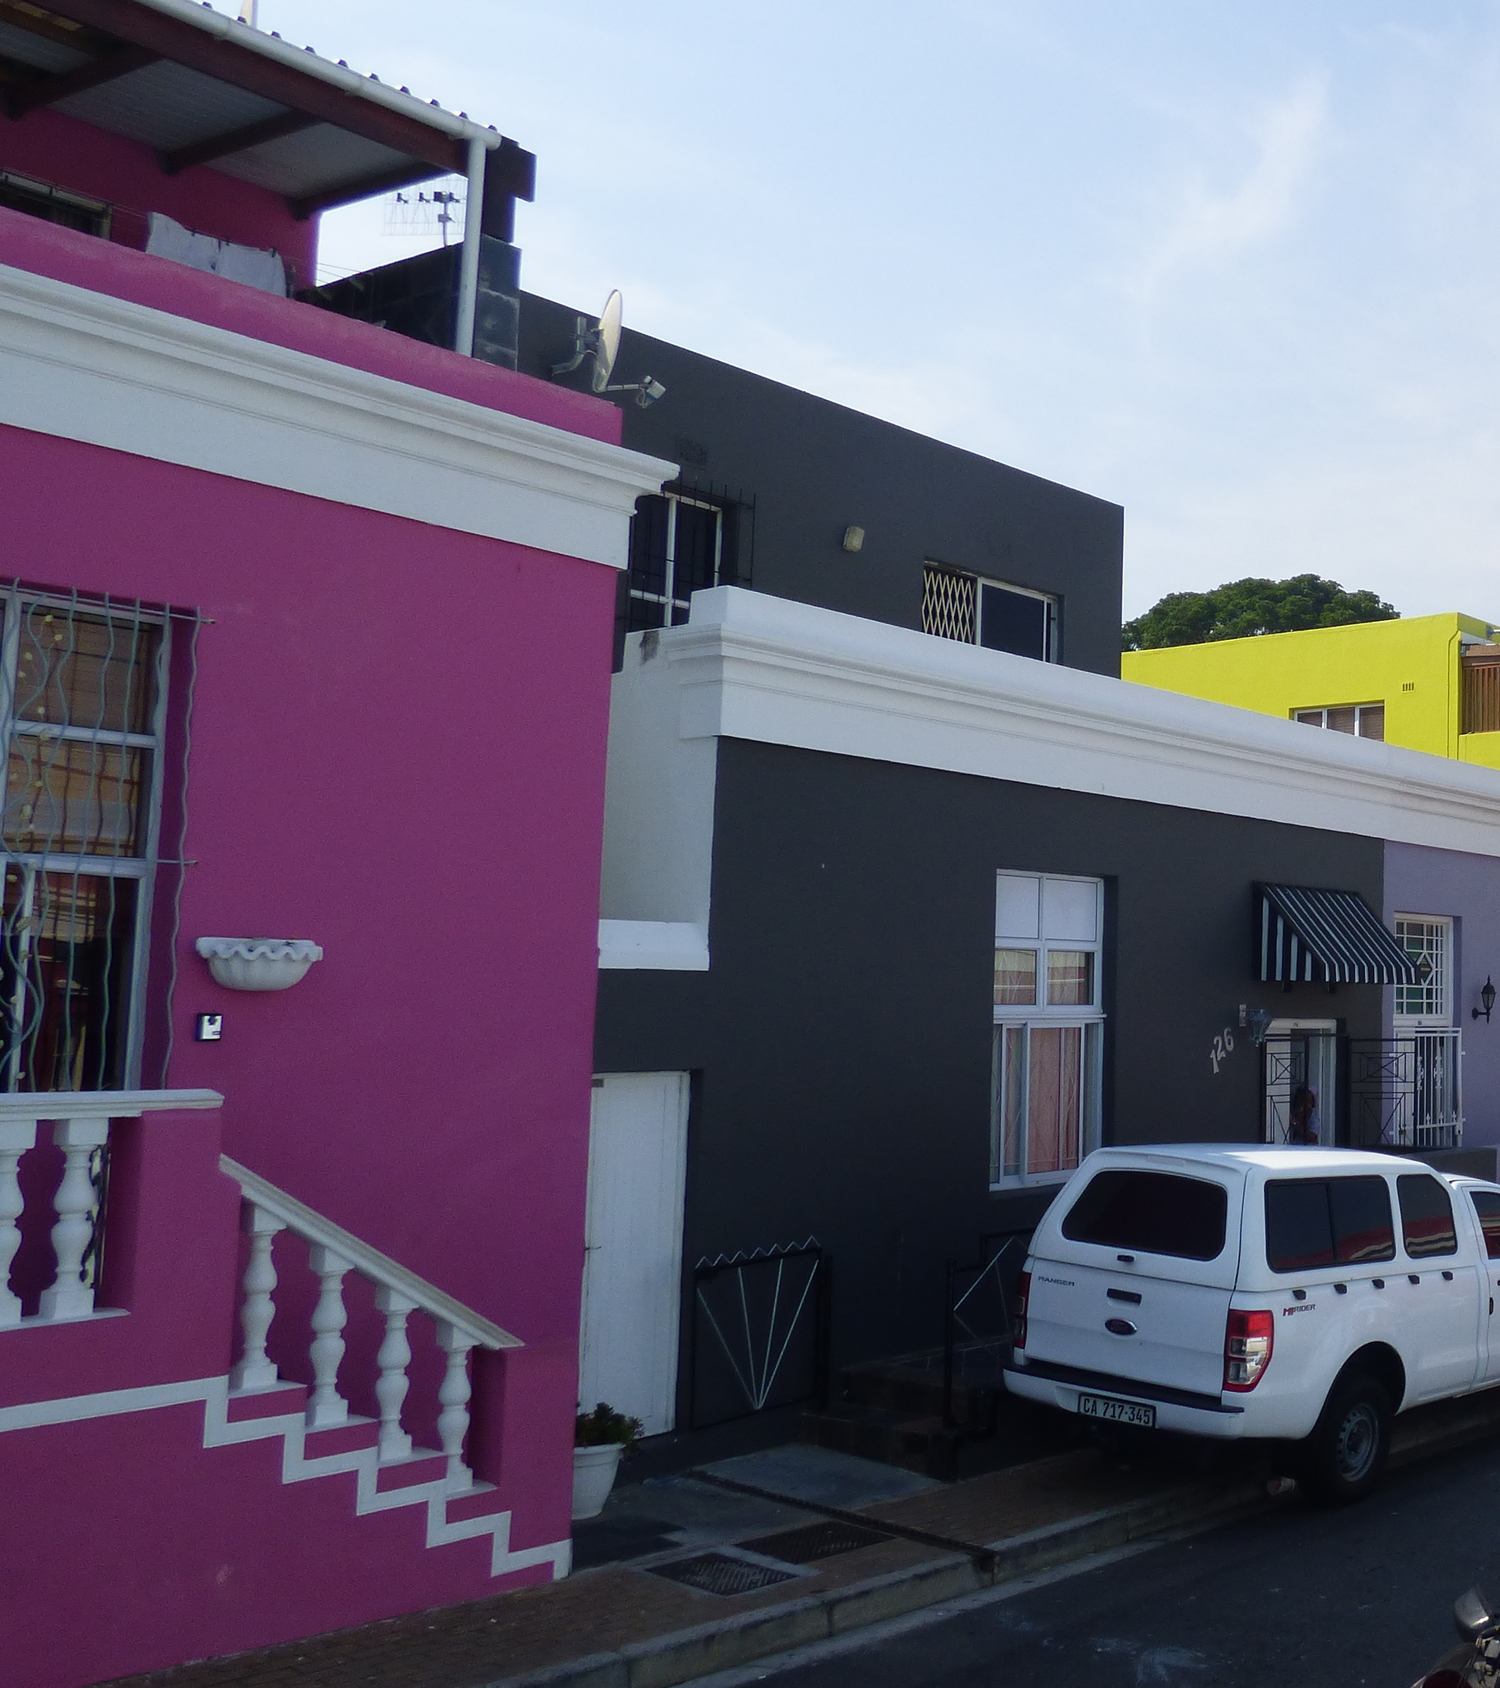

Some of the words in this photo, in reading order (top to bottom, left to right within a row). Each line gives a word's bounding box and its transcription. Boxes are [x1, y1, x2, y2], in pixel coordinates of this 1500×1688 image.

[1209, 1026, 1235, 1074] 126
[1037, 1275, 1075, 1287] RANGER
[1083, 1398, 1097, 1415] CA
